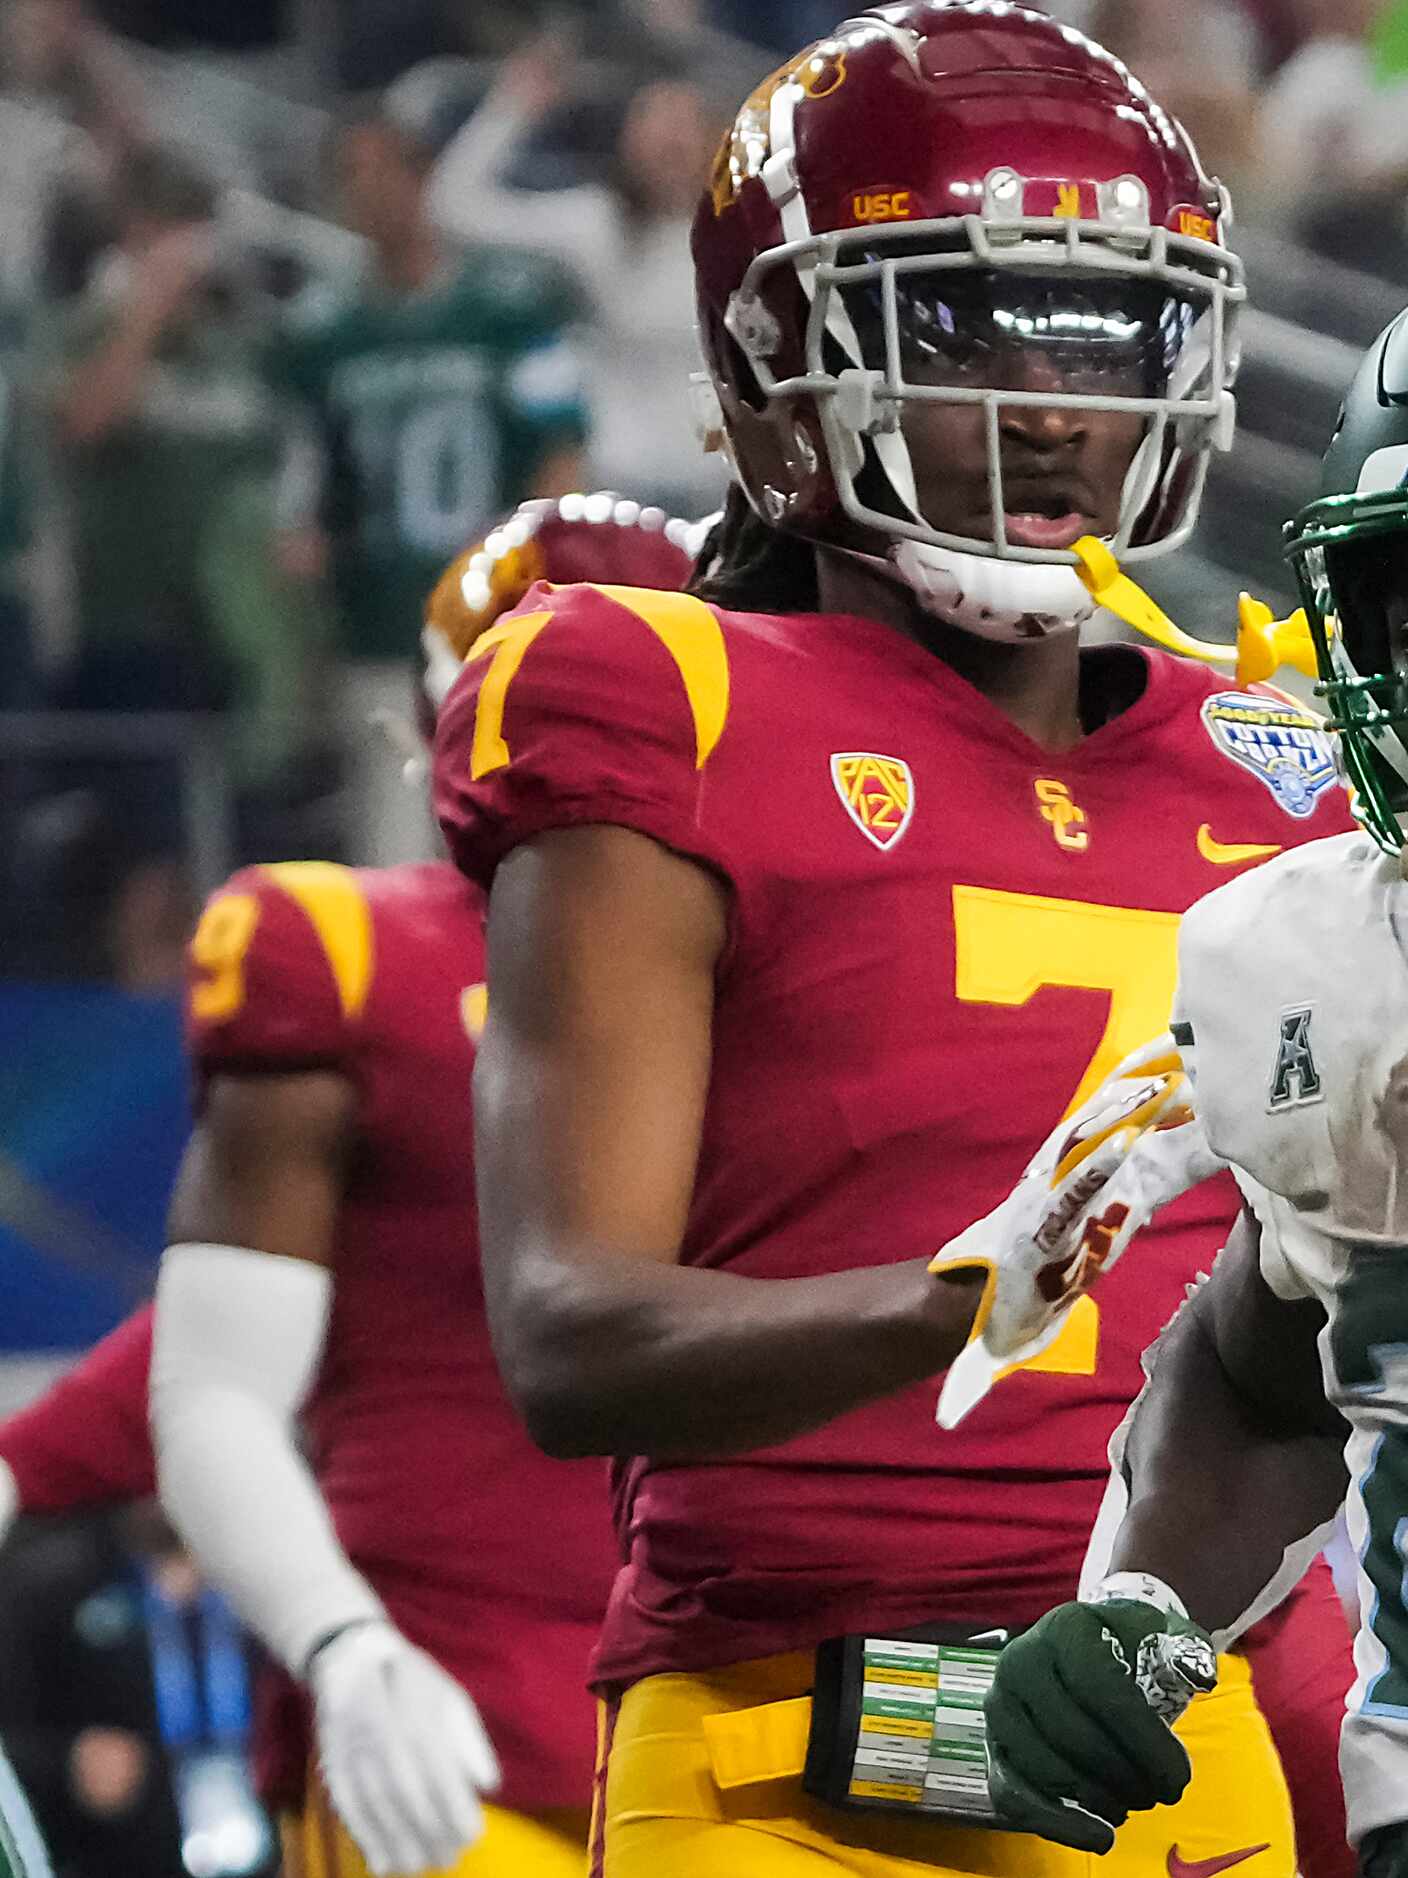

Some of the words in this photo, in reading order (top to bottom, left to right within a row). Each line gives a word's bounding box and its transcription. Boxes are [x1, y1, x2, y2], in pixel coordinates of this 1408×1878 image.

[853, 191, 911, 220] USC
[1178, 211, 1213, 242] USC
[838, 757, 909, 812] PAC
[858, 793, 899, 828] 12
[191, 894, 261, 1021] 9
